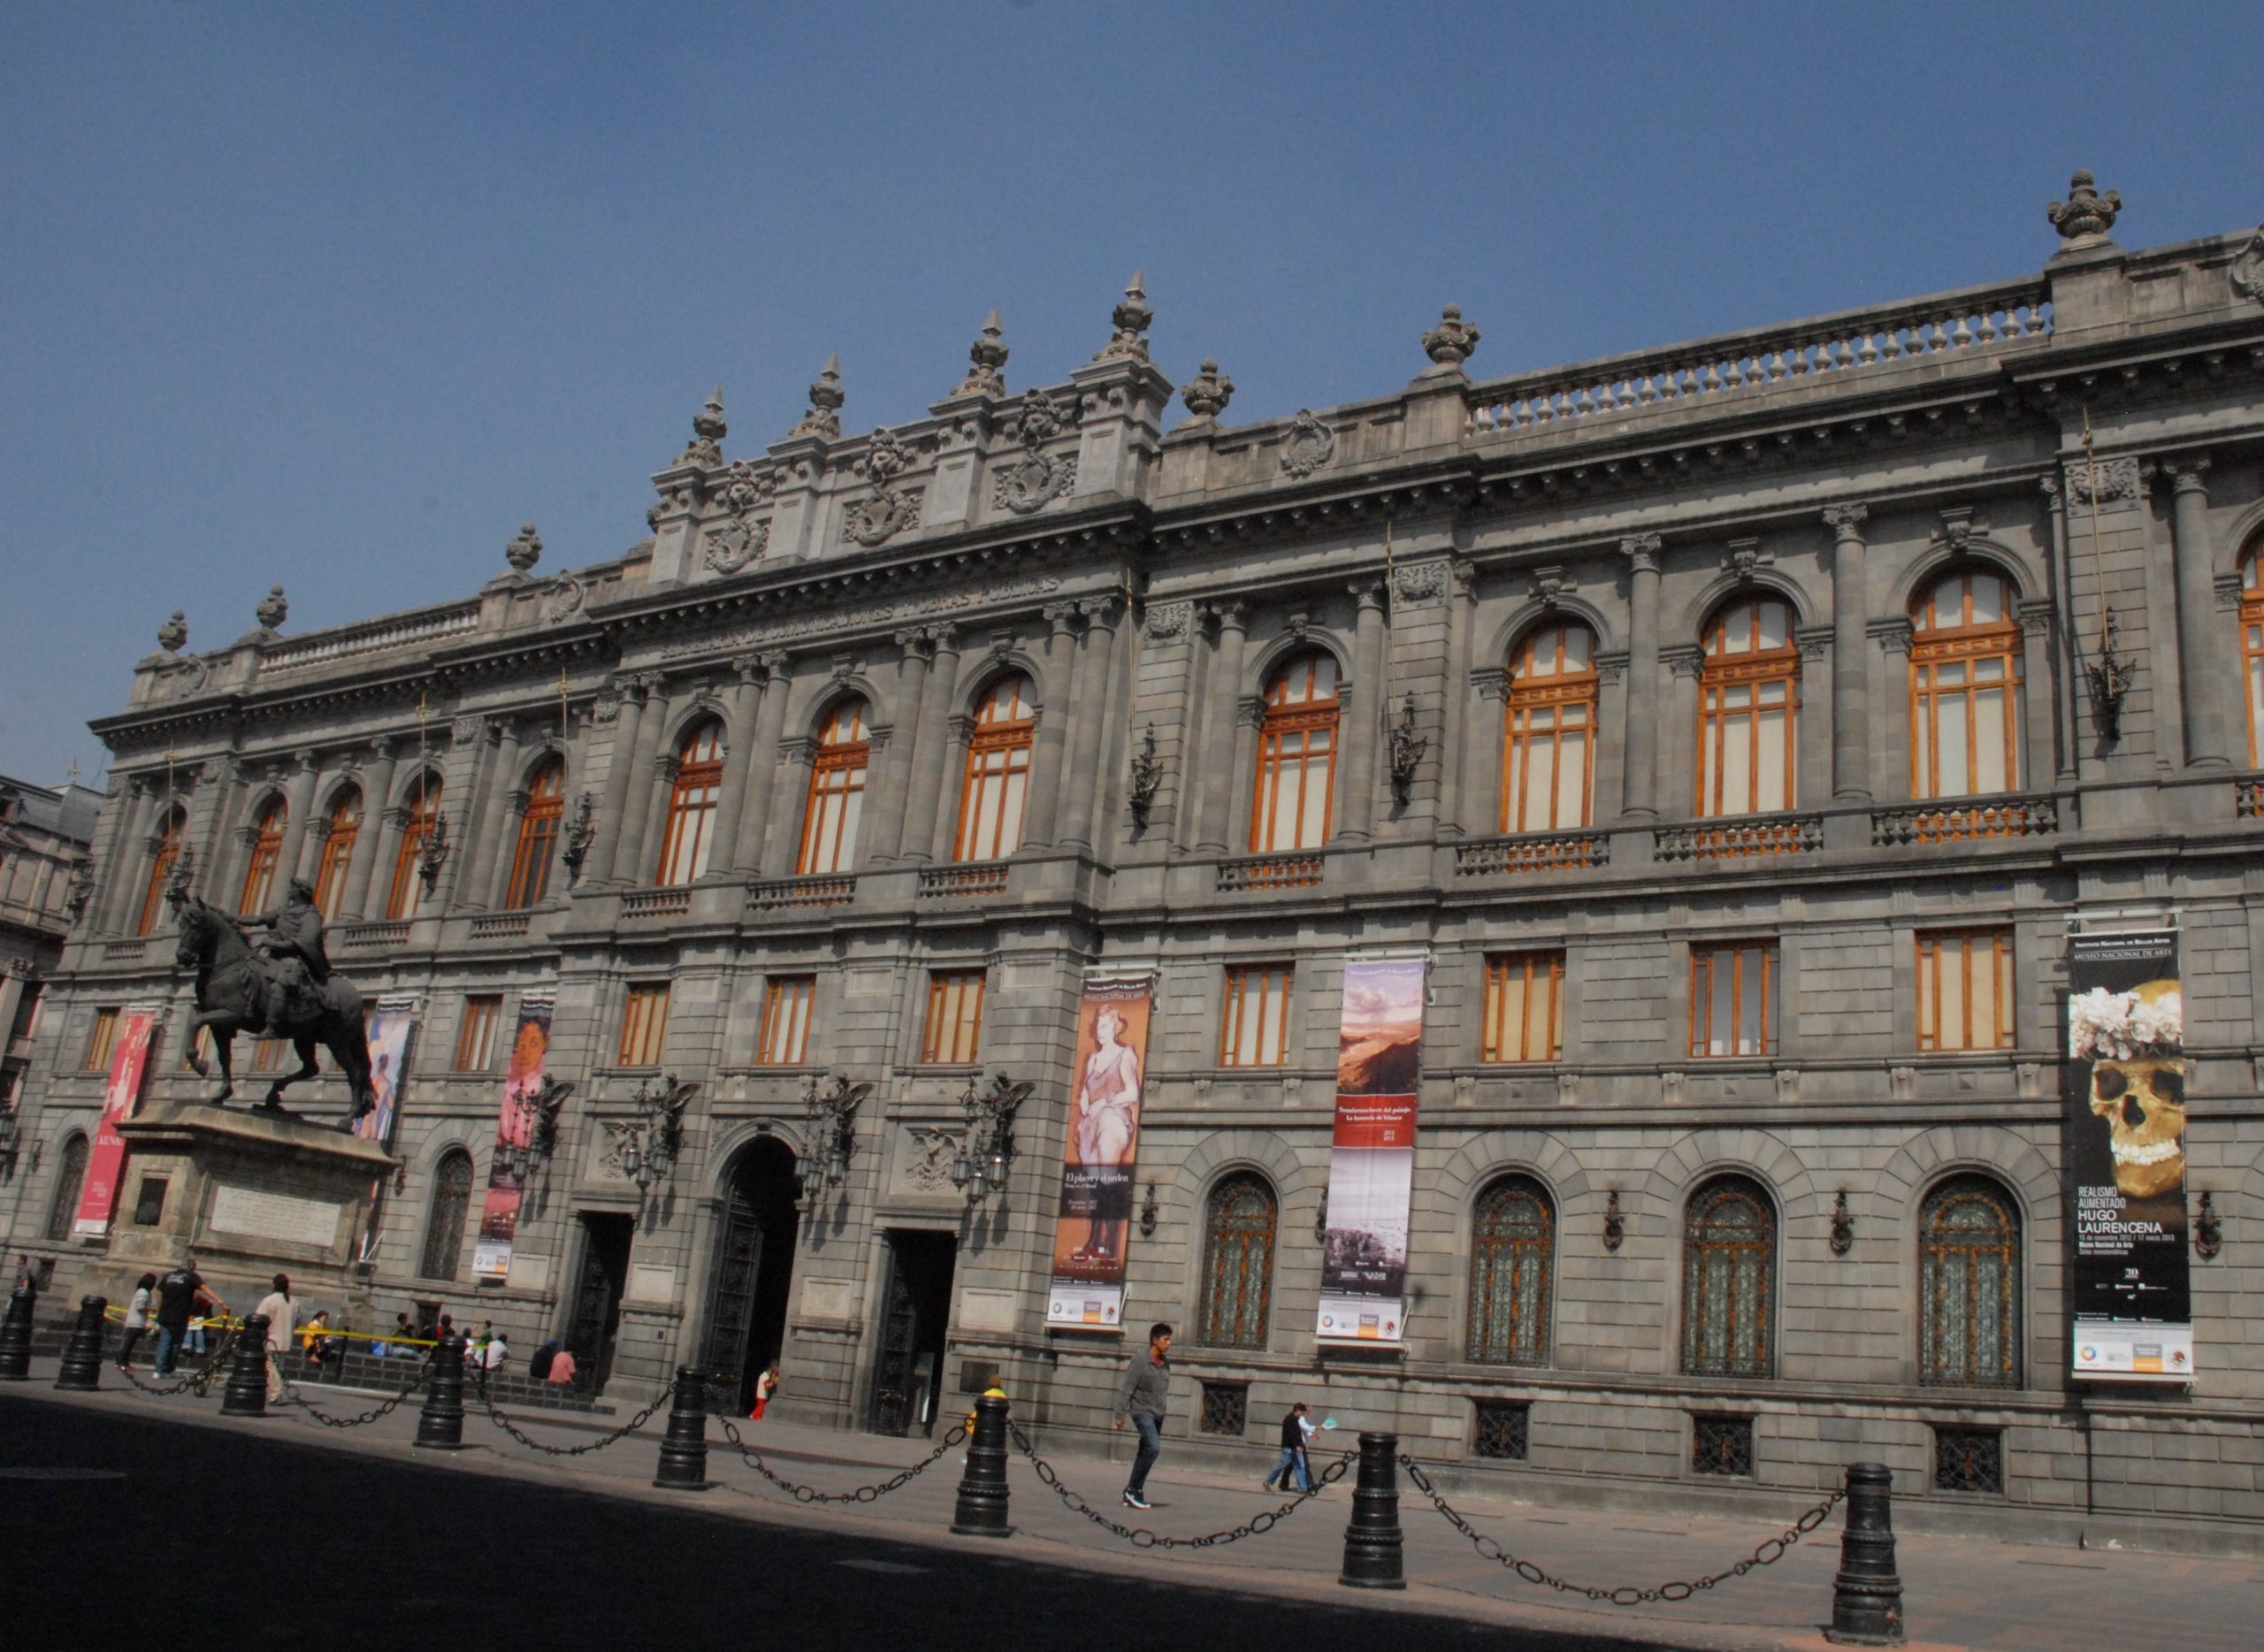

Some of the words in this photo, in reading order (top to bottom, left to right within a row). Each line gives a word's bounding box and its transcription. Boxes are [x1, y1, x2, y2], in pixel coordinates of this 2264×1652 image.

[1066, 1173, 1075, 1182] El
[1100, 1174, 1107, 1182] el
[2078, 1186, 2117, 1197] REALISMO
[2078, 1197, 2126, 1209] AUMENTADO
[2077, 1209, 2117, 1221] HUGO
[2077, 1221, 2162, 1234] LAURENCENA
